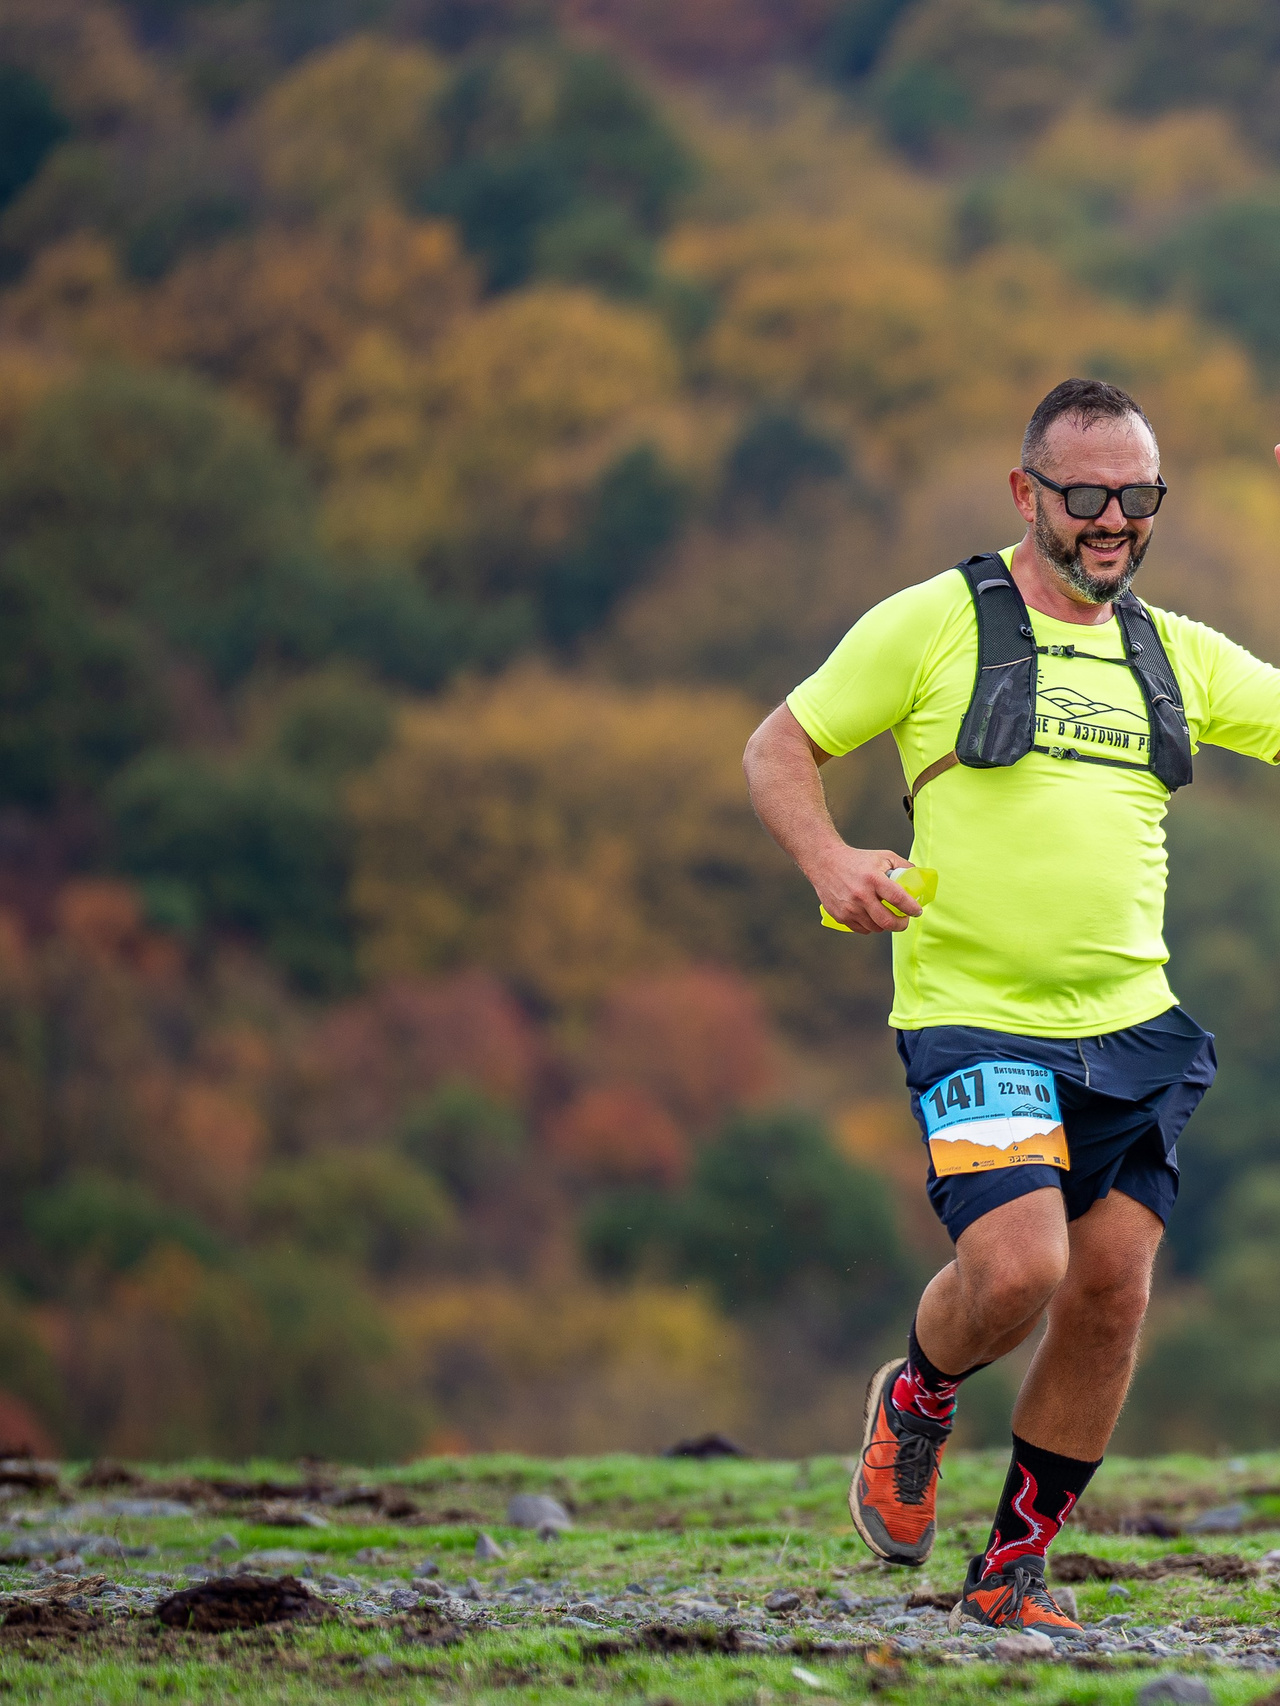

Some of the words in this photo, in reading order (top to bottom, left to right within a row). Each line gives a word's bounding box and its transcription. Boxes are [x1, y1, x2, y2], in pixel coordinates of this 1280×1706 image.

[1057, 721, 1066, 736] В
[1073, 724, 1130, 749] ИЗТОЧНИ
[928, 1068, 986, 1119] 147
[998, 1081, 1016, 1096] 22
